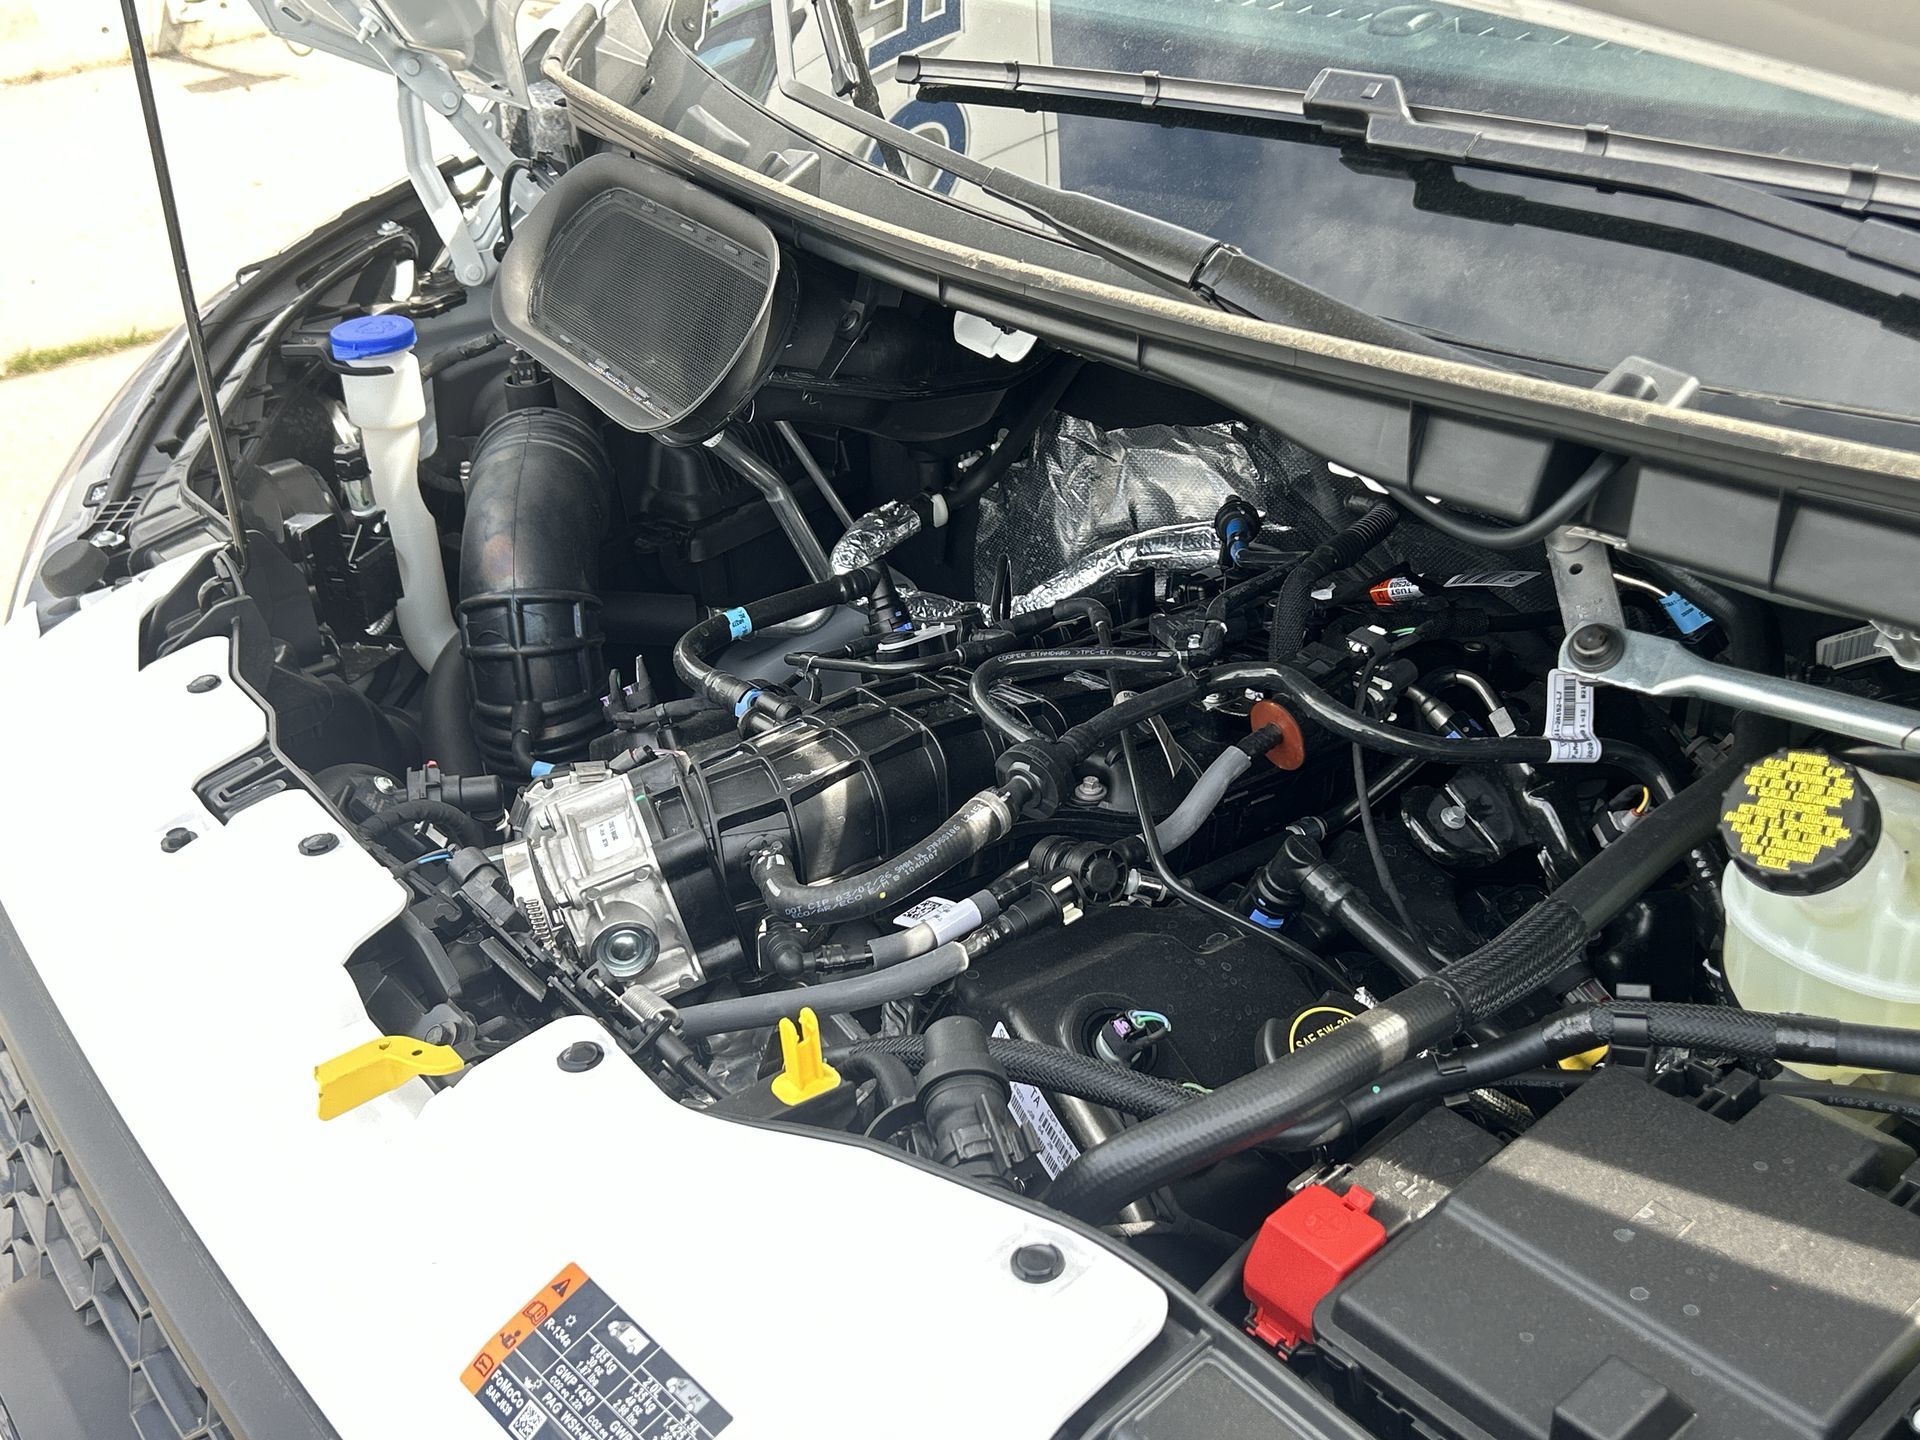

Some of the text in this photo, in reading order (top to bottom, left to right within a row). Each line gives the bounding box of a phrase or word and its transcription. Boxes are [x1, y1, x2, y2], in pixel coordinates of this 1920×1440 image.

[997, 652, 1025, 662] COOPER
[1029, 1087, 1042, 1108] TA
[544, 1318, 571, 1347] R-134a
[594, 1366, 604, 1376] oz
[605, 1358, 617, 1375] kg
[486, 1385, 501, 1403] SAE
[491, 1369, 524, 1408] FoMoCo
[556, 1365, 595, 1406] GWP 1430
[643, 1375, 665, 1399] 2.0L
[542, 1392, 562, 1414] PAG
[633, 1405, 643, 1416] oz
[642, 1397, 656, 1415] kg
